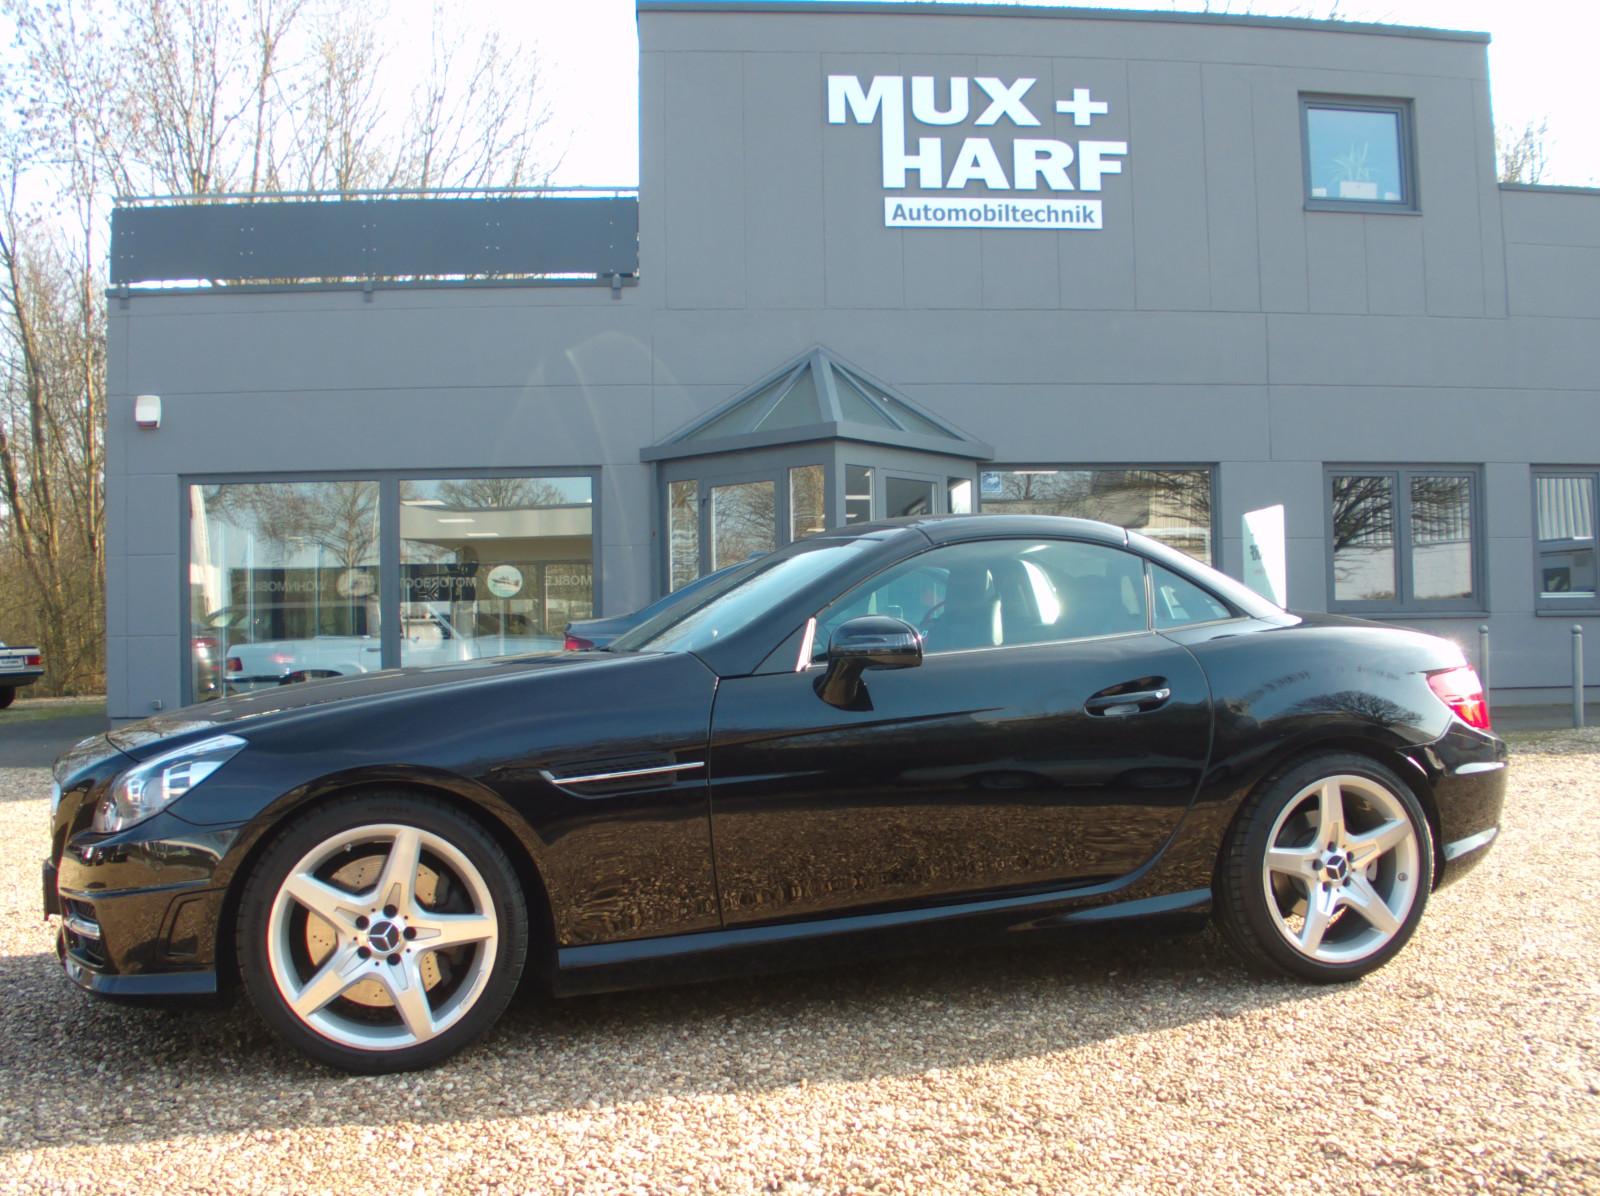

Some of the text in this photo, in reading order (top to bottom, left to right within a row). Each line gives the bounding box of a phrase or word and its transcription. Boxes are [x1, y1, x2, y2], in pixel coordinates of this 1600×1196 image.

[828, 75, 1108, 126] MUX +
[883, 137, 1127, 191] HARF
[892, 203, 1095, 224] Automobiltechnik
